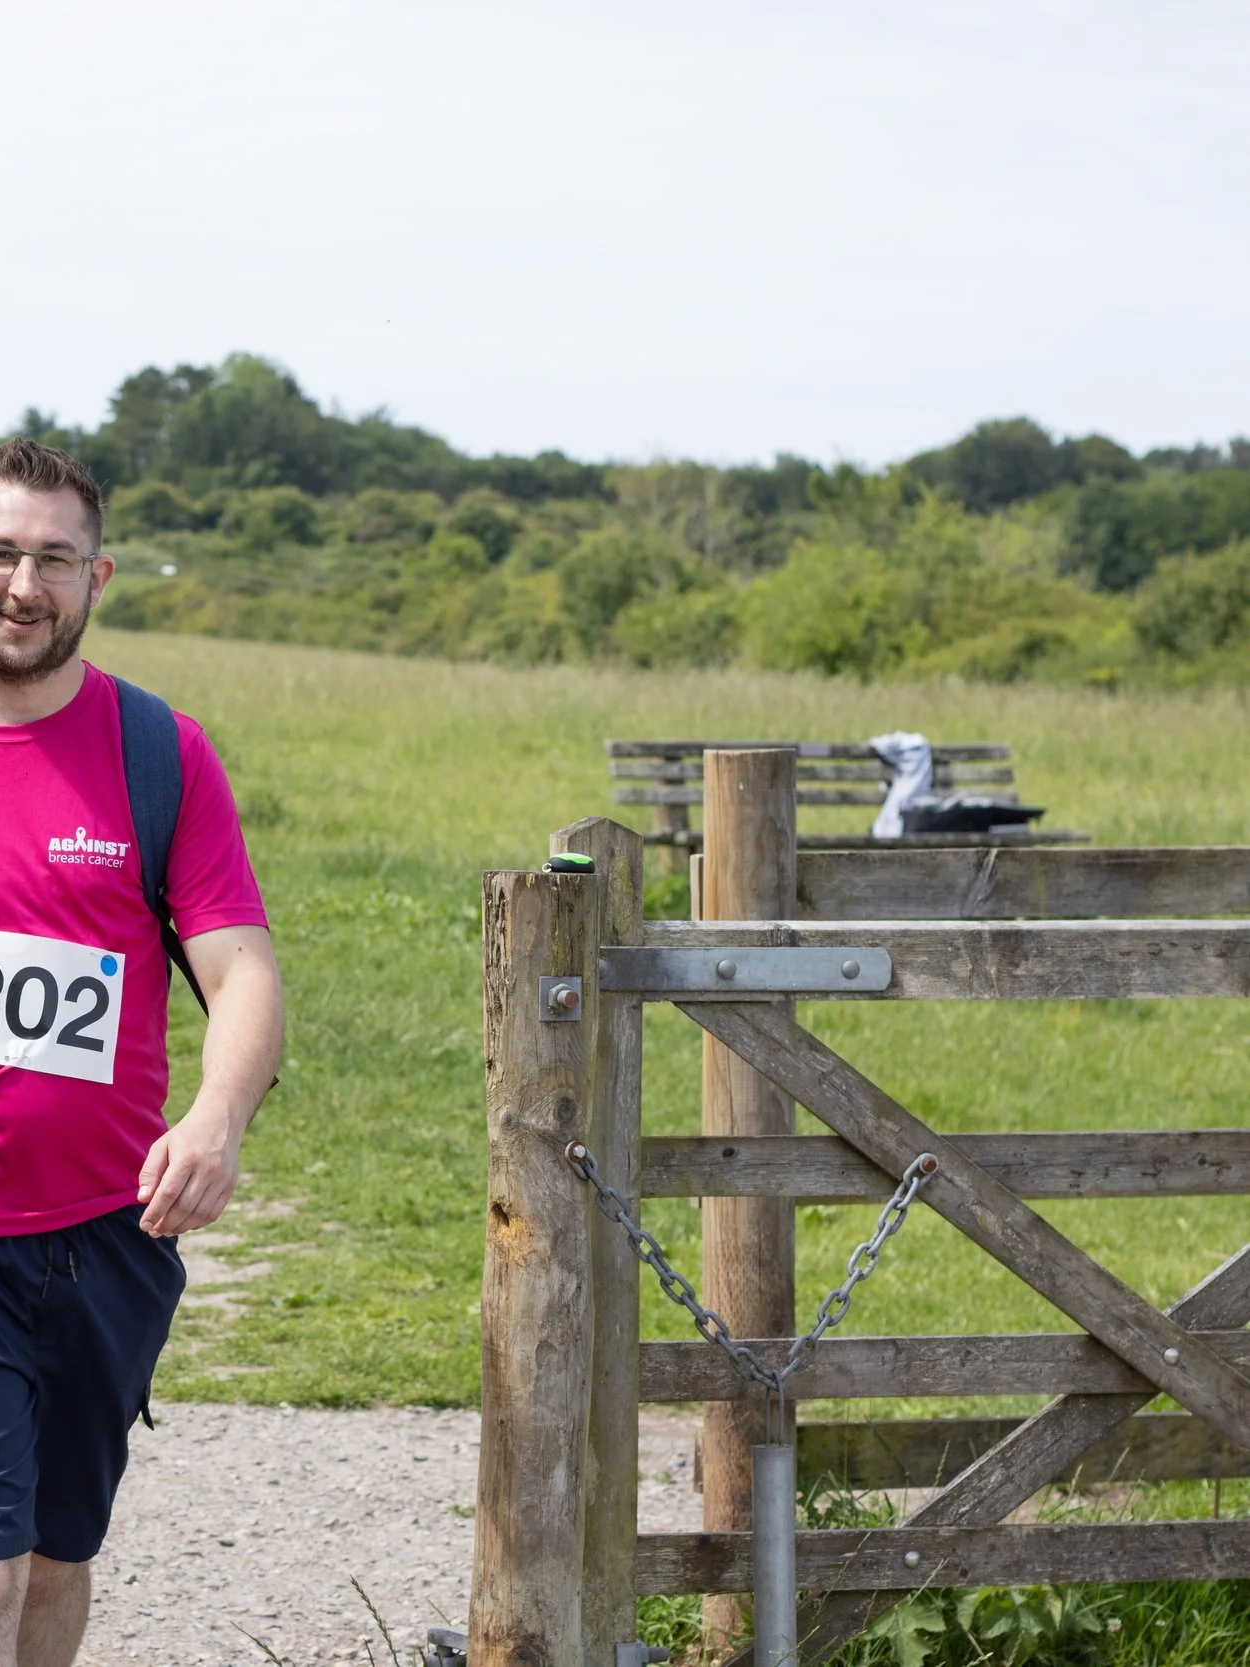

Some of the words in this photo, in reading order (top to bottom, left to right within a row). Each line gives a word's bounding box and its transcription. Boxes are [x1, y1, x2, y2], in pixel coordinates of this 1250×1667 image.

[48, 826, 129, 857] AGAINST
[48, 851, 85, 864] breast
[88, 855, 125, 868] cancer
